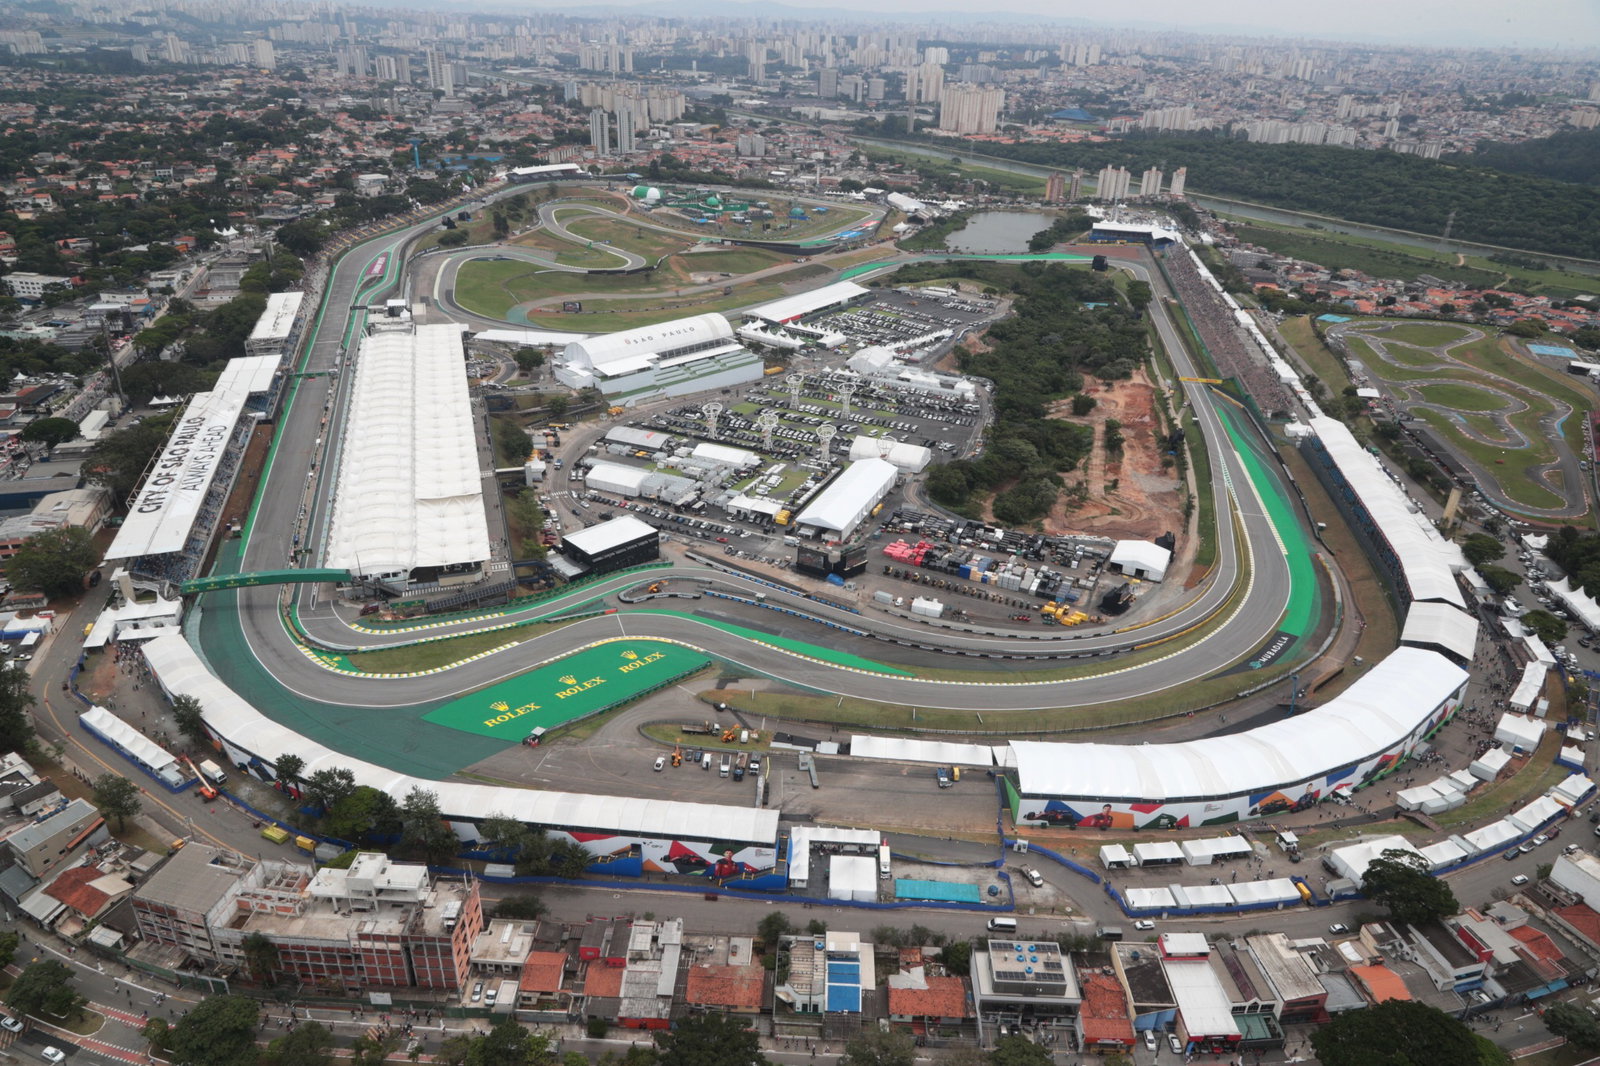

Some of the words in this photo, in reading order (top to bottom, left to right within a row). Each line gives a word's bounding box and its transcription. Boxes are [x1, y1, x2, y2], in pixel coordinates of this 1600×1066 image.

[662, 326, 695, 337] PAULO
[174, 417, 206, 446] PAULO
[161, 448, 190, 469] SÃO
[181, 454, 215, 491] ALWAYS
[200, 425, 228, 453] AHEAD
[152, 472, 177, 486] OF
[138, 490, 168, 513] CITY
[1259, 636, 1289, 662] MUBADALA
[618, 651, 667, 673] ROLEX
[555, 676, 607, 699] ROLEX
[484, 702, 543, 727] ROLEX
